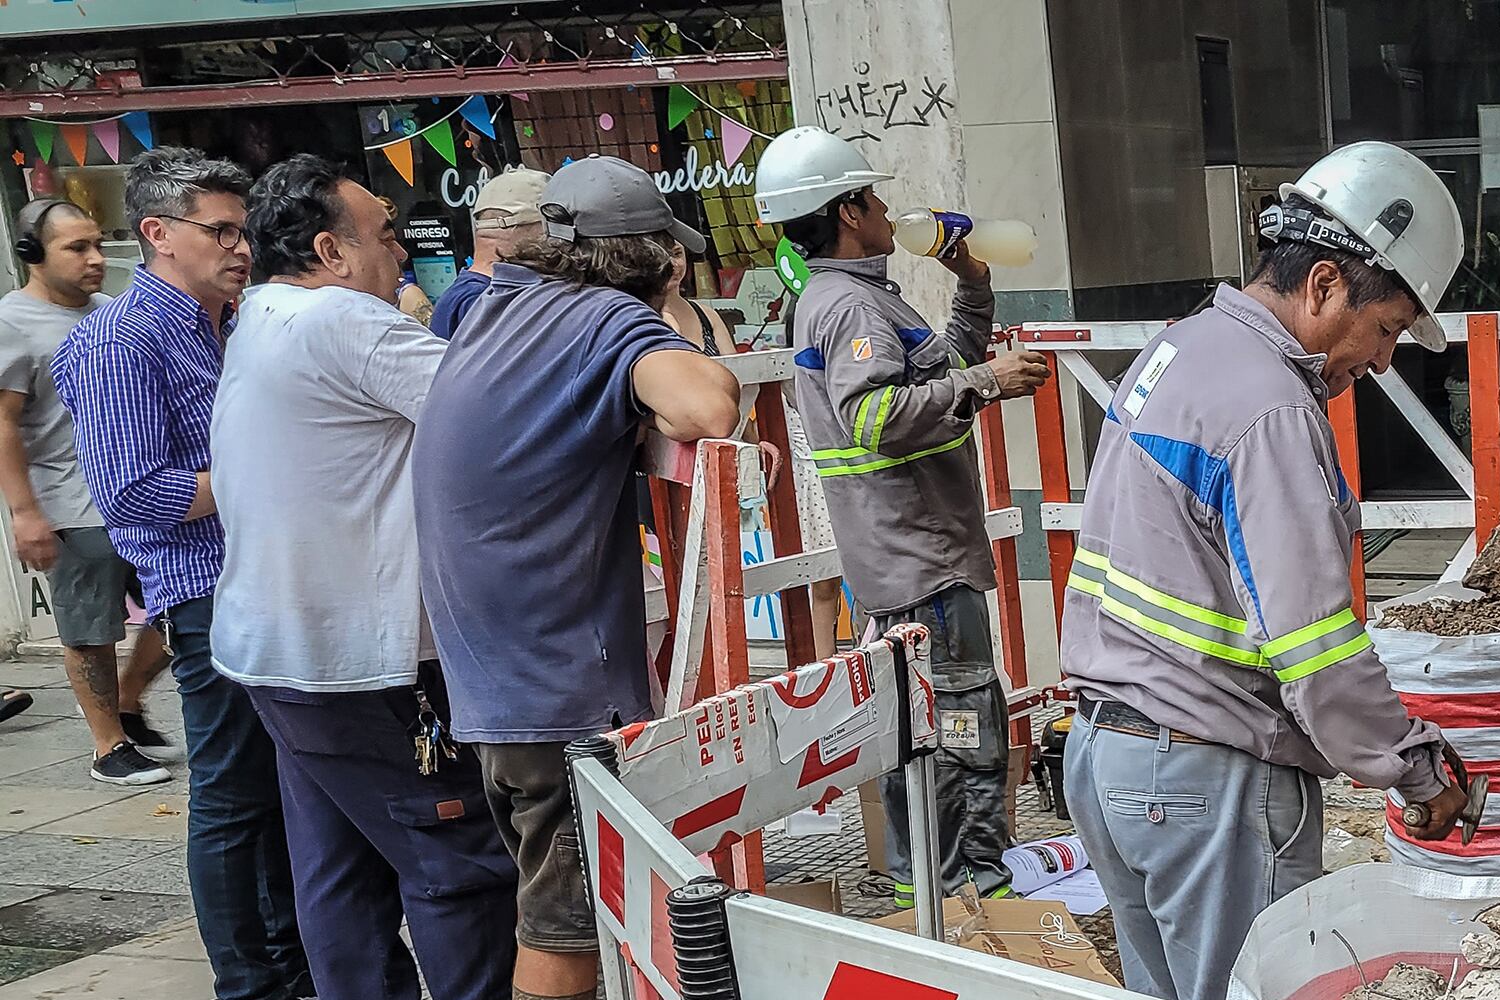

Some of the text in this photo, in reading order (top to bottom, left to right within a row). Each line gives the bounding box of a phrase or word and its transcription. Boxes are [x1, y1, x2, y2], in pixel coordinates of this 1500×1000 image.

[654, 146, 755, 194] pelera
[403, 226, 450, 239] INGRESO
[695, 706, 714, 767] PEL
